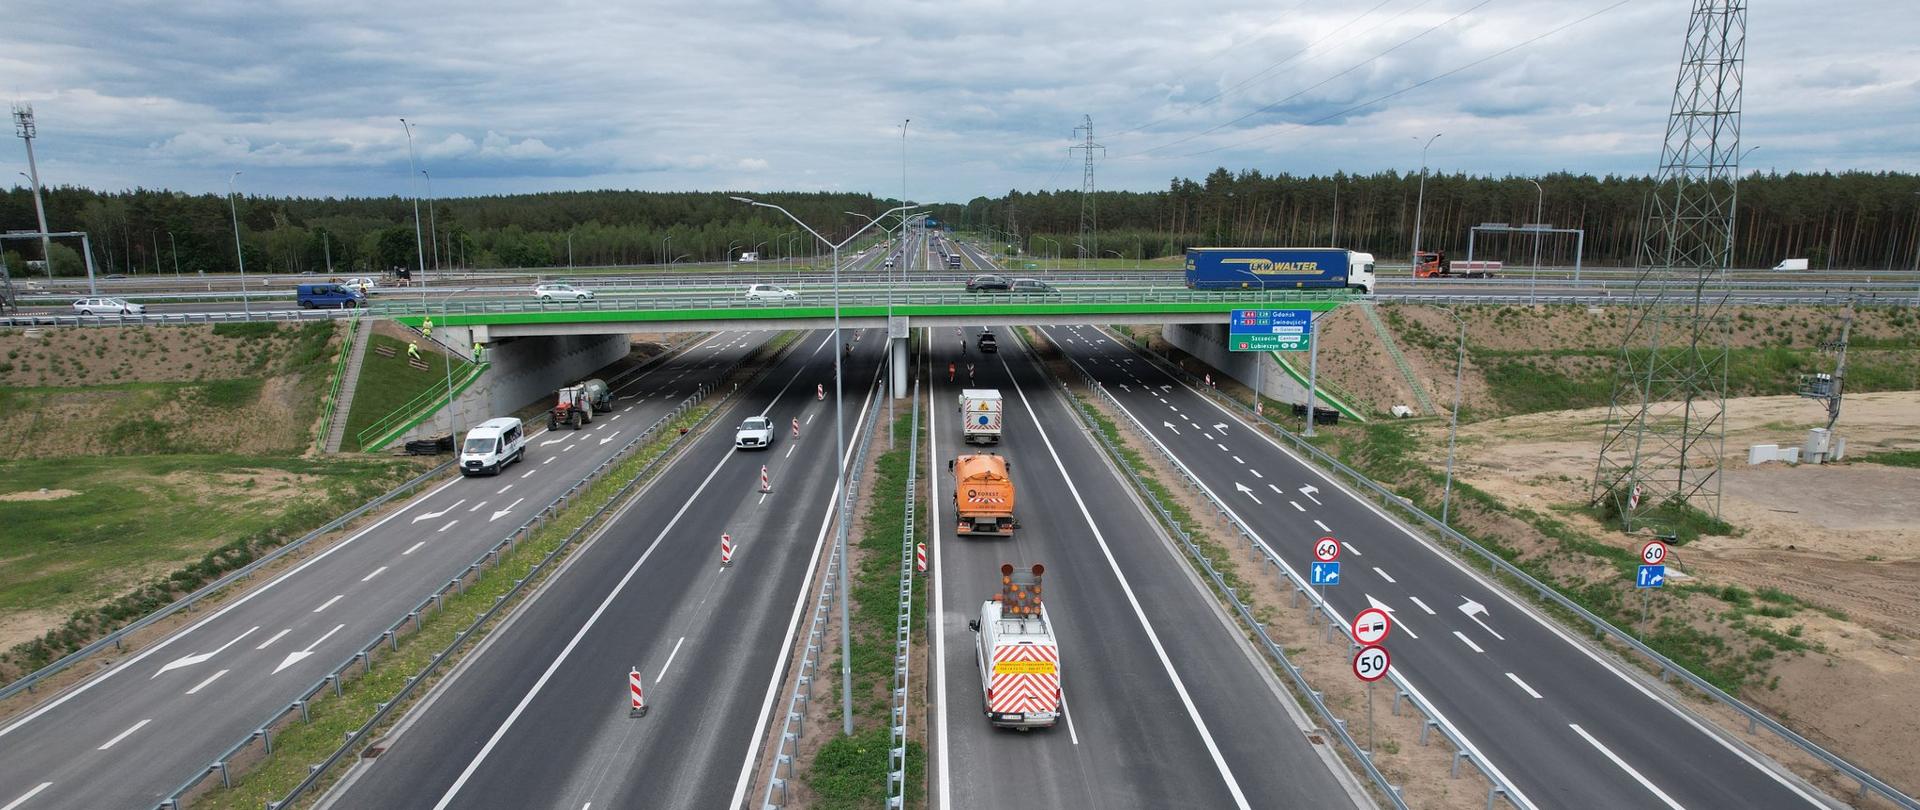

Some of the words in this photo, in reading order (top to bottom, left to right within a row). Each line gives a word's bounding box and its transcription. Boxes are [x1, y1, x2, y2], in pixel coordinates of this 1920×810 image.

[1251, 262, 1272, 271] LKW
[1274, 262, 1317, 271] WALTER
[1318, 544, 1336, 556] 60
[1645, 547, 1662, 559] 60
[1361, 655, 1384, 673] 50
